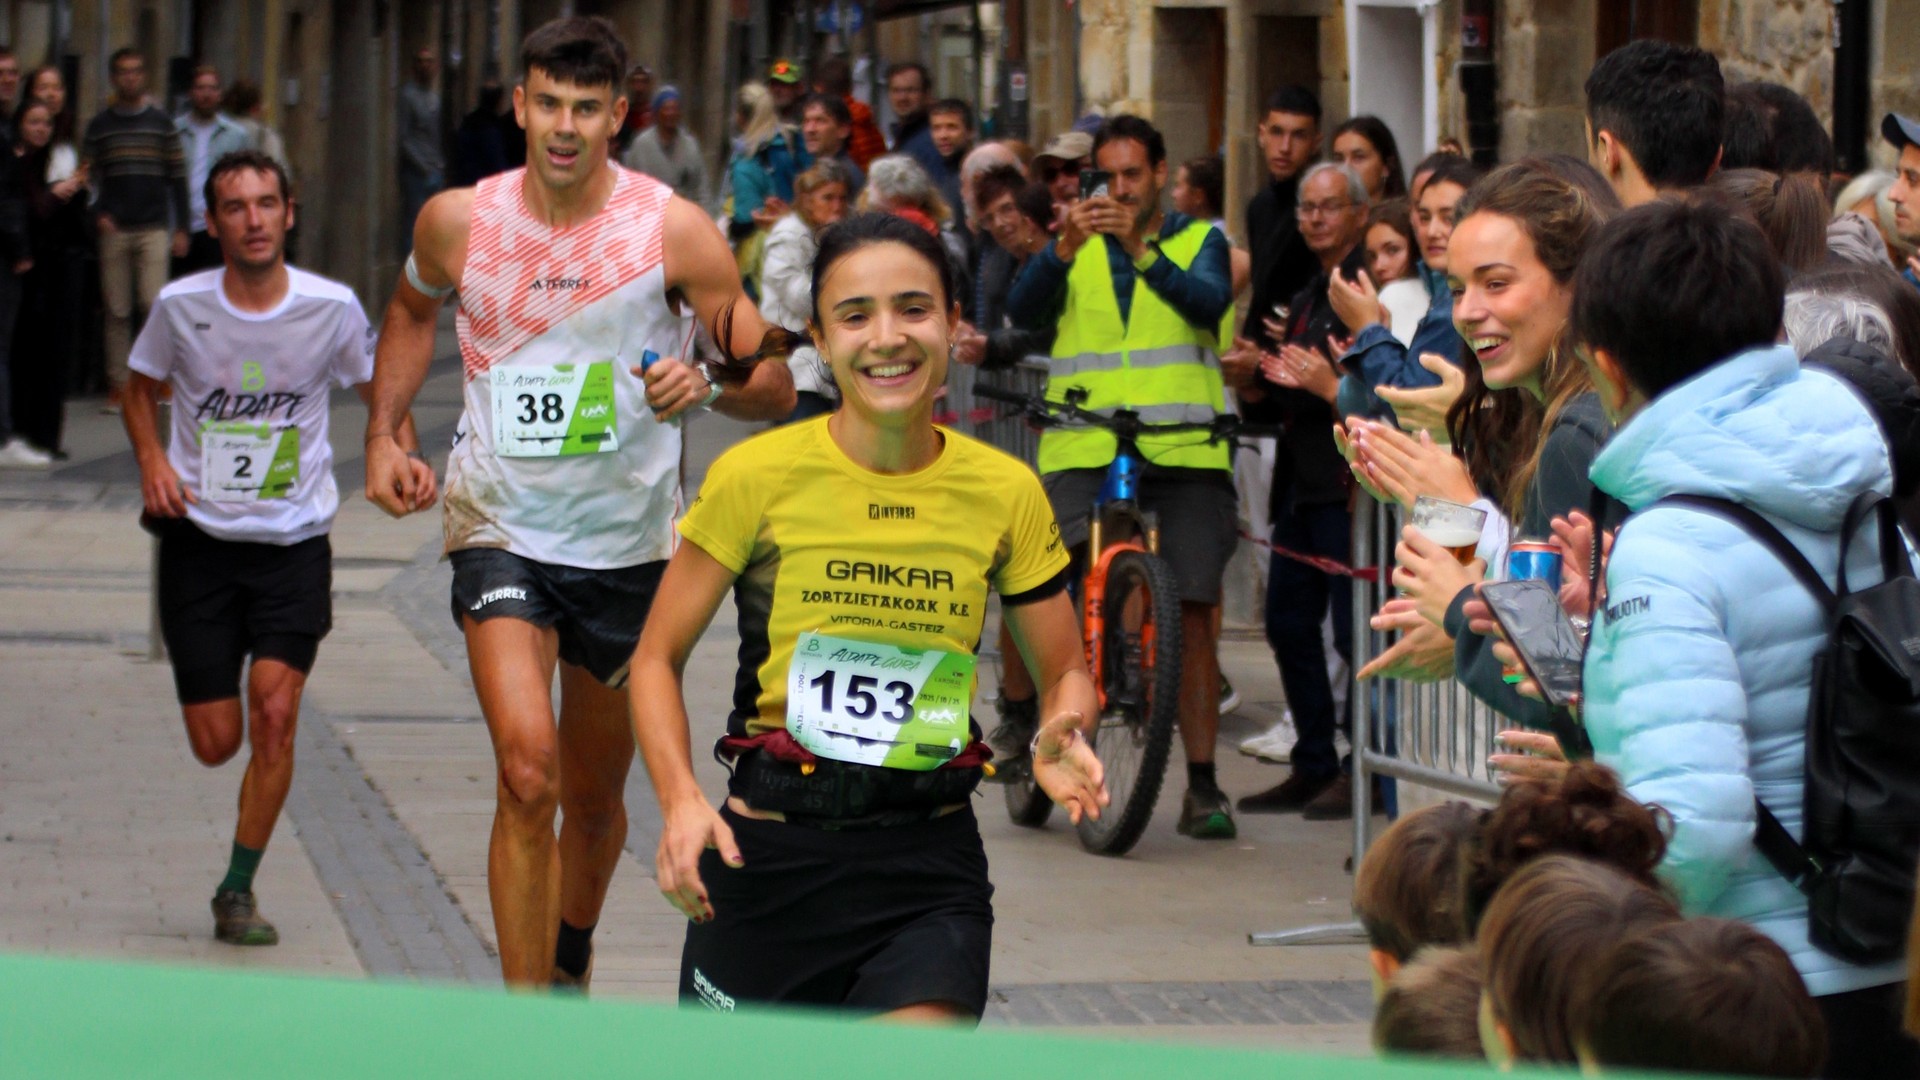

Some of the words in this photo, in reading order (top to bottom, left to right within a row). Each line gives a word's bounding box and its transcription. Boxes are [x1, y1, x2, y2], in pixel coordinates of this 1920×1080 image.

[545, 278, 590, 291] TERREX
[516, 393, 565, 425] 38
[233, 455, 252, 478] 2
[826, 560, 954, 592] GAIKAR
[481, 587, 527, 606] TERREX
[801, 590, 938, 614] ZORTZIETAKOAK
[831, 615, 945, 634] VITORIA-GASTEIZ
[810, 669, 915, 725] 153
[694, 967, 736, 1012] GAIKAR
